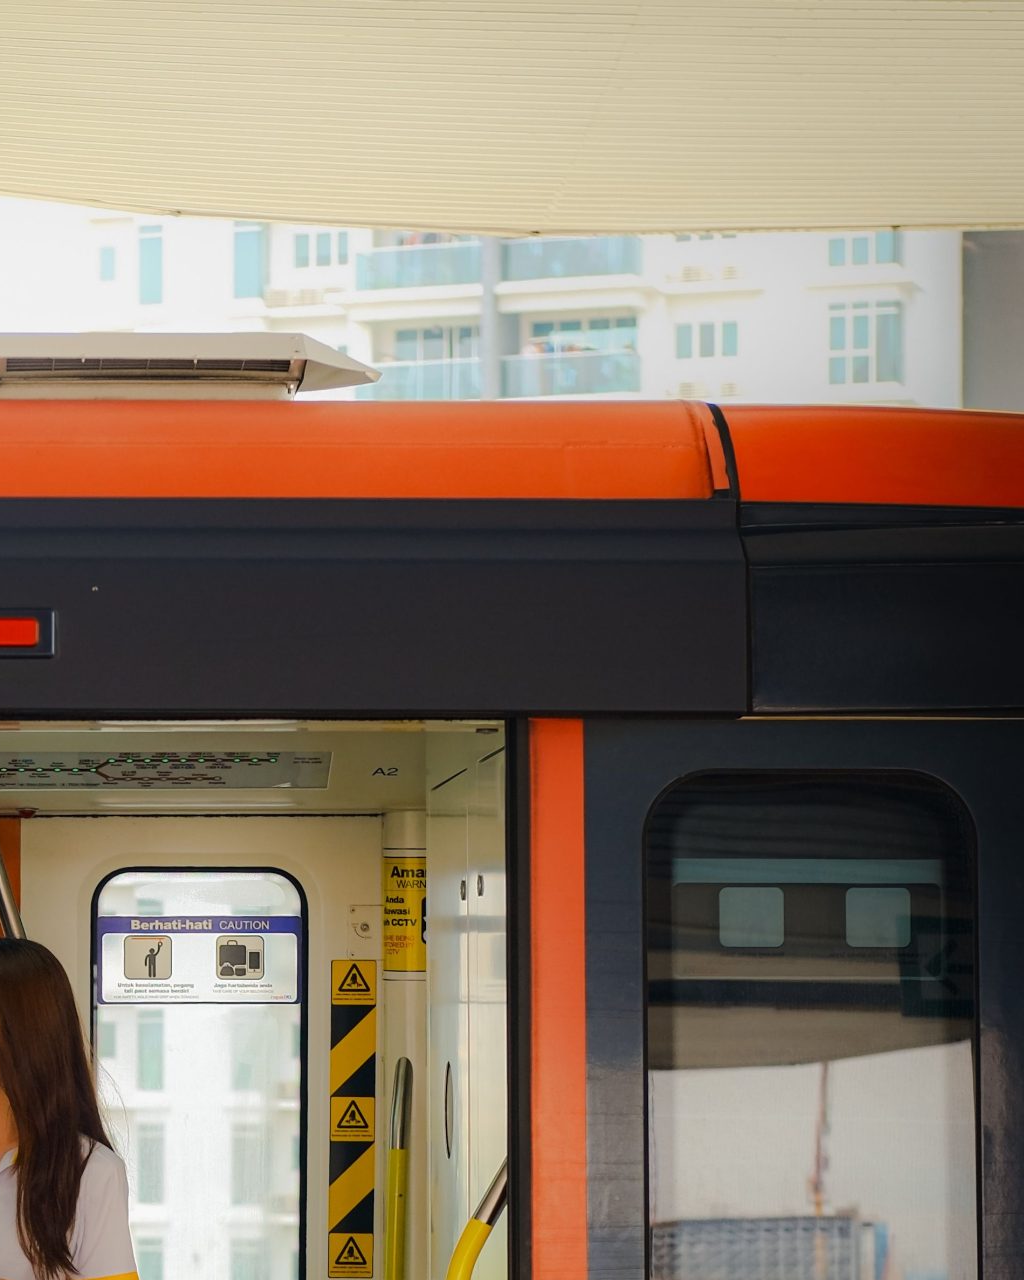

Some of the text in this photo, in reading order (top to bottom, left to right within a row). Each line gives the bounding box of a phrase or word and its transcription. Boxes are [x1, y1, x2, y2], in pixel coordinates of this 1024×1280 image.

[372, 767, 398, 776] A2
[131, 919, 270, 930] Berhati-hati CAUTION
[391, 918, 417, 926] CCTV
